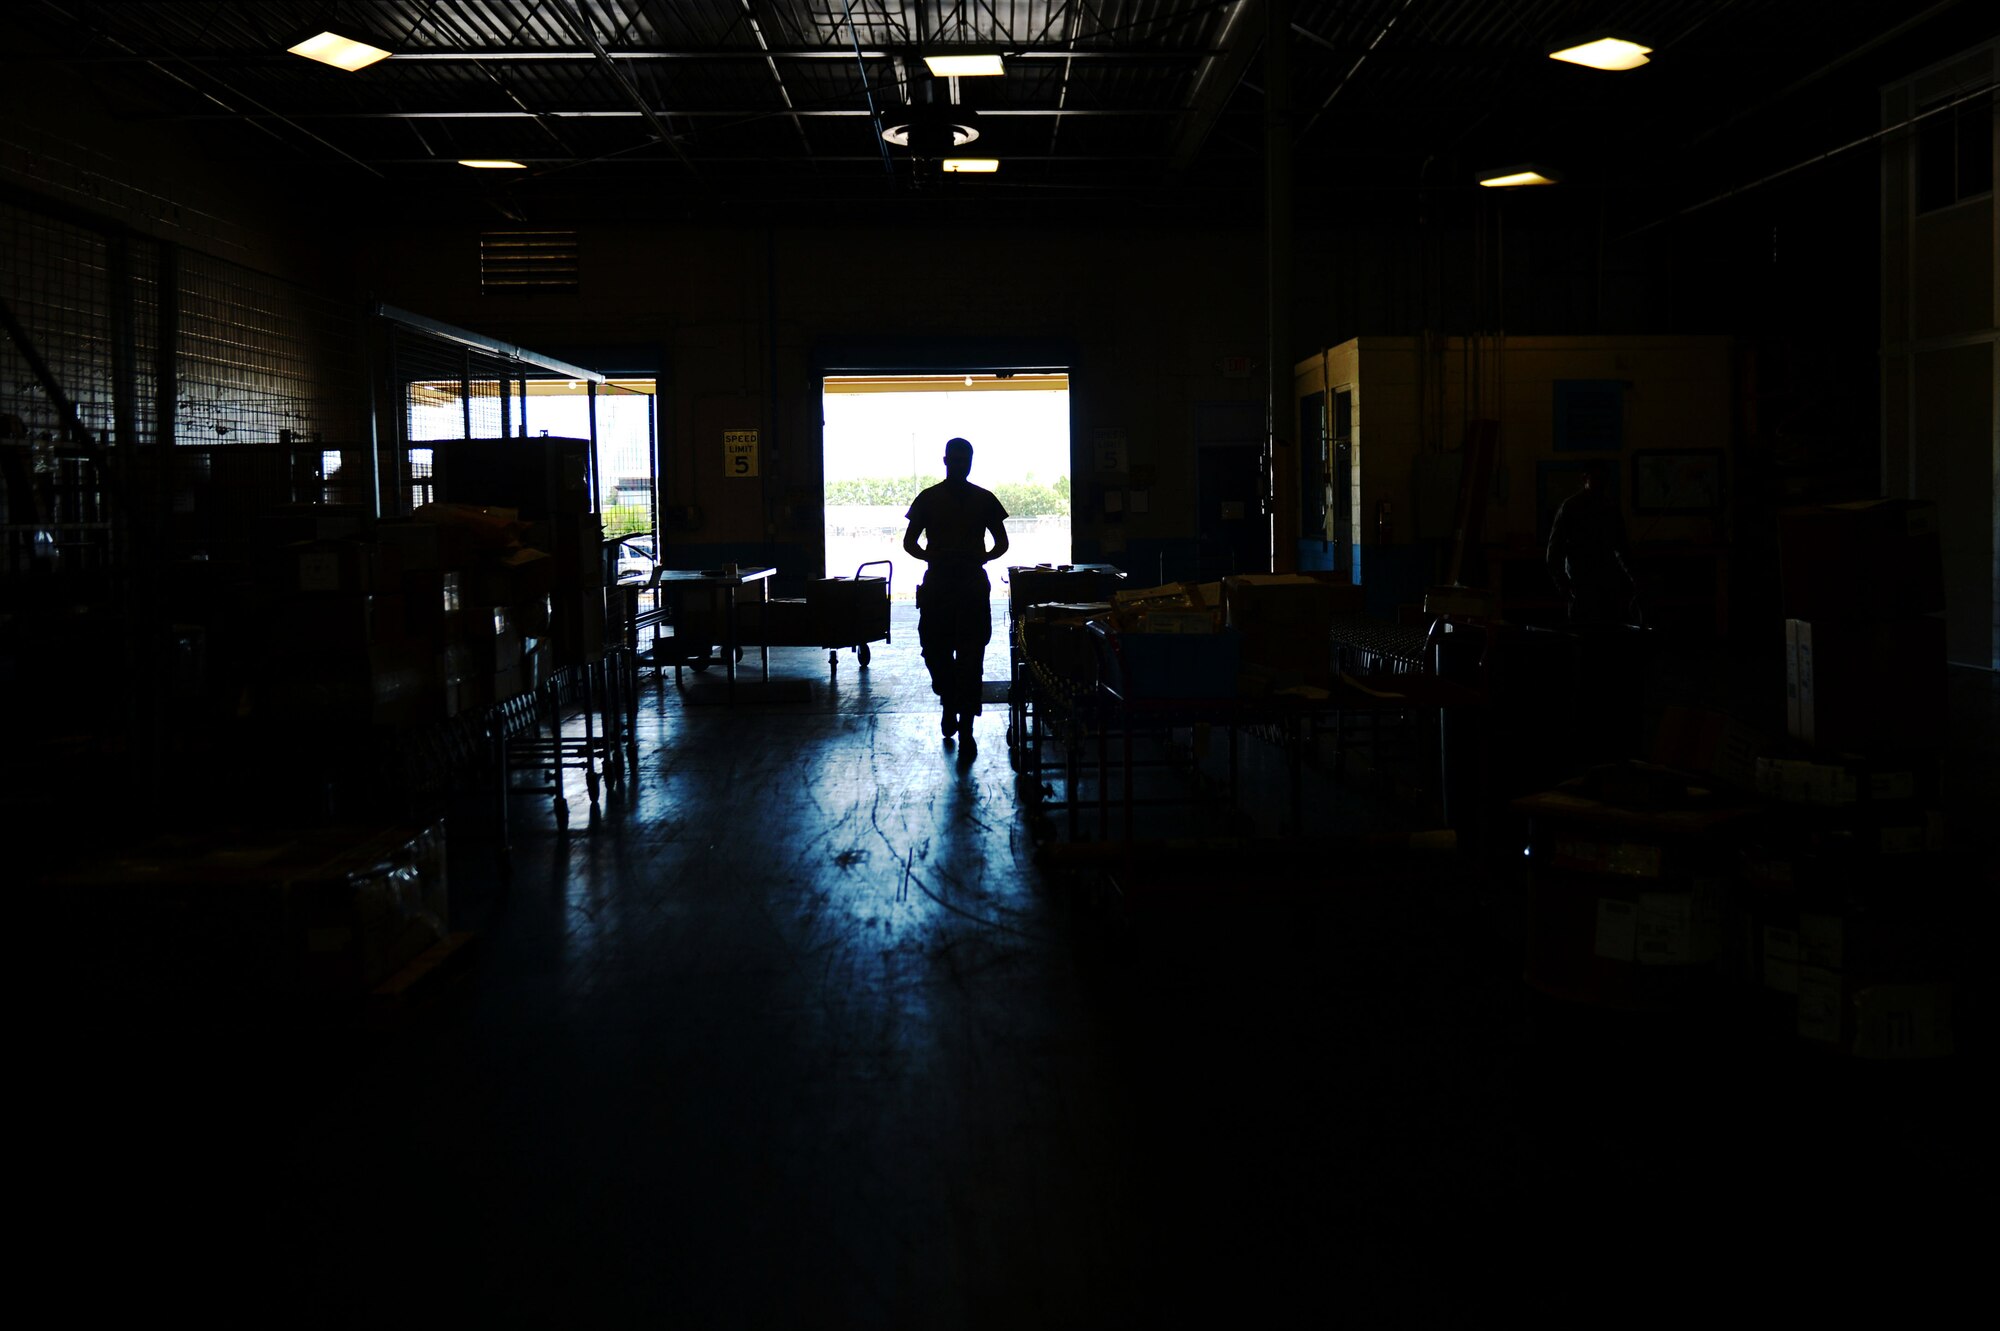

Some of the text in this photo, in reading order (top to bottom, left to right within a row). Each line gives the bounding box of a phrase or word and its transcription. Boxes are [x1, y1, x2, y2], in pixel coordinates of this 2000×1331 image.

[725, 434, 757, 443] SPEED
[729, 445, 753, 453] LIMIT
[735, 456, 749, 474] 5
[1104, 450, 1118, 469] 5
